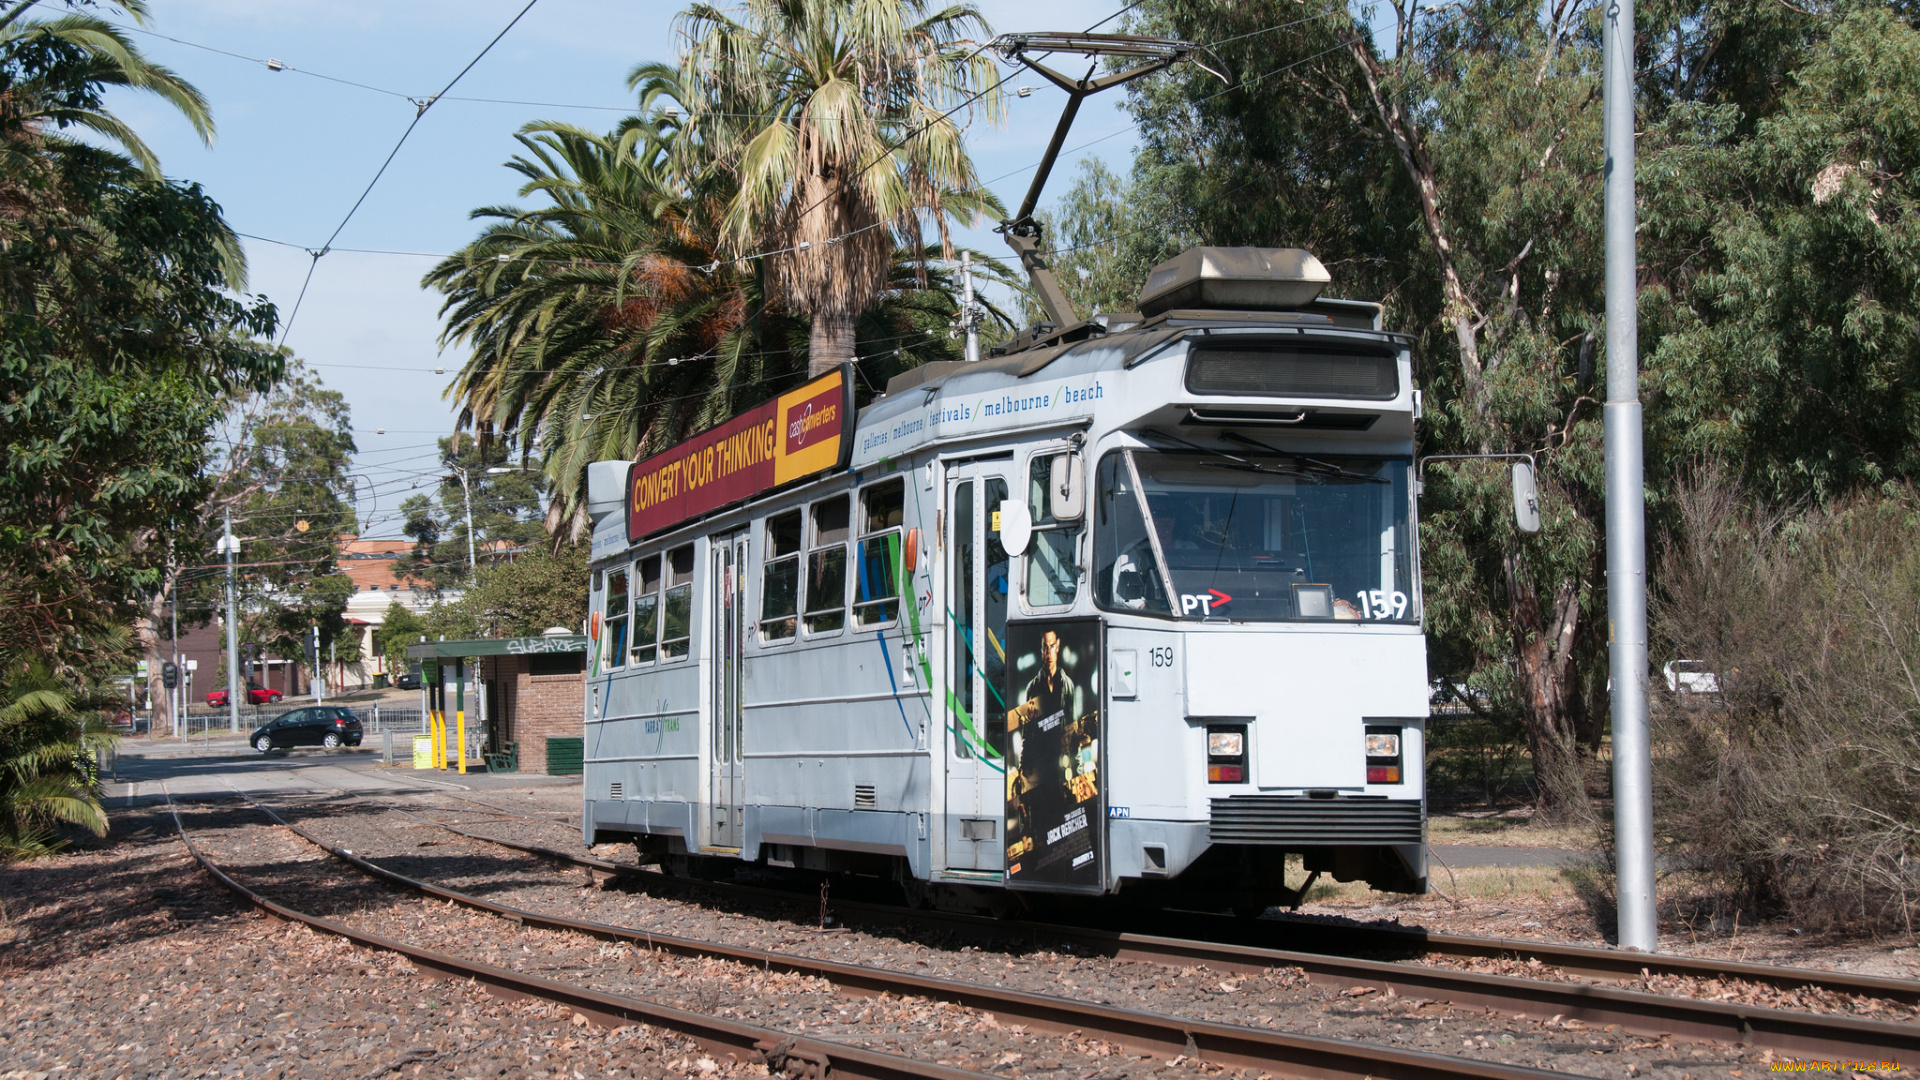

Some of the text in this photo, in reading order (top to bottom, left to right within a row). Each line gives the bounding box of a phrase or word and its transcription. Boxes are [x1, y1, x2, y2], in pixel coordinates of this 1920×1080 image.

[863, 381, 1103, 454] galleries melbourne festivals melbourne beach
[634, 418, 777, 513] CONVERT YOUR THINKING.
[1356, 590, 1408, 620] 159
[1149, 647, 1174, 668] 159
[664, 718, 680, 732] TRAMS
[1110, 807, 1129, 818] APN
[1046, 827, 1062, 846] JACK
[1061, 814, 1088, 838] REACHER
